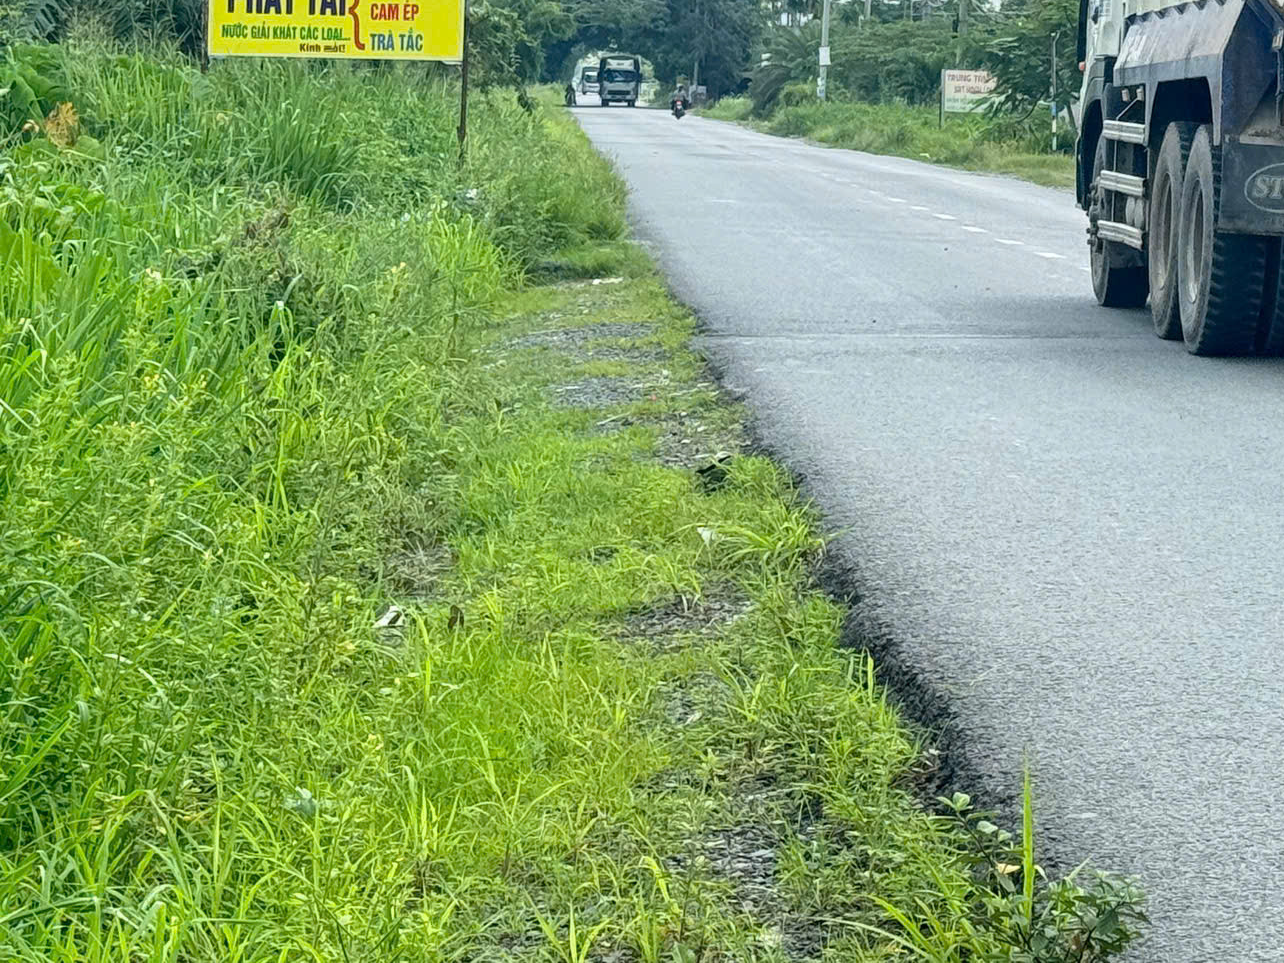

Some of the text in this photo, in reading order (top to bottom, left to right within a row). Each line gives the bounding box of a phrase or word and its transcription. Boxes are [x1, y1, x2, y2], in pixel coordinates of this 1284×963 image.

[370, 0, 420, 21] CAM ÉP
[273, 23, 297, 40] KHÁT
[300, 24, 319, 40] CÁC
[370, 29, 394, 51] TRÀ
